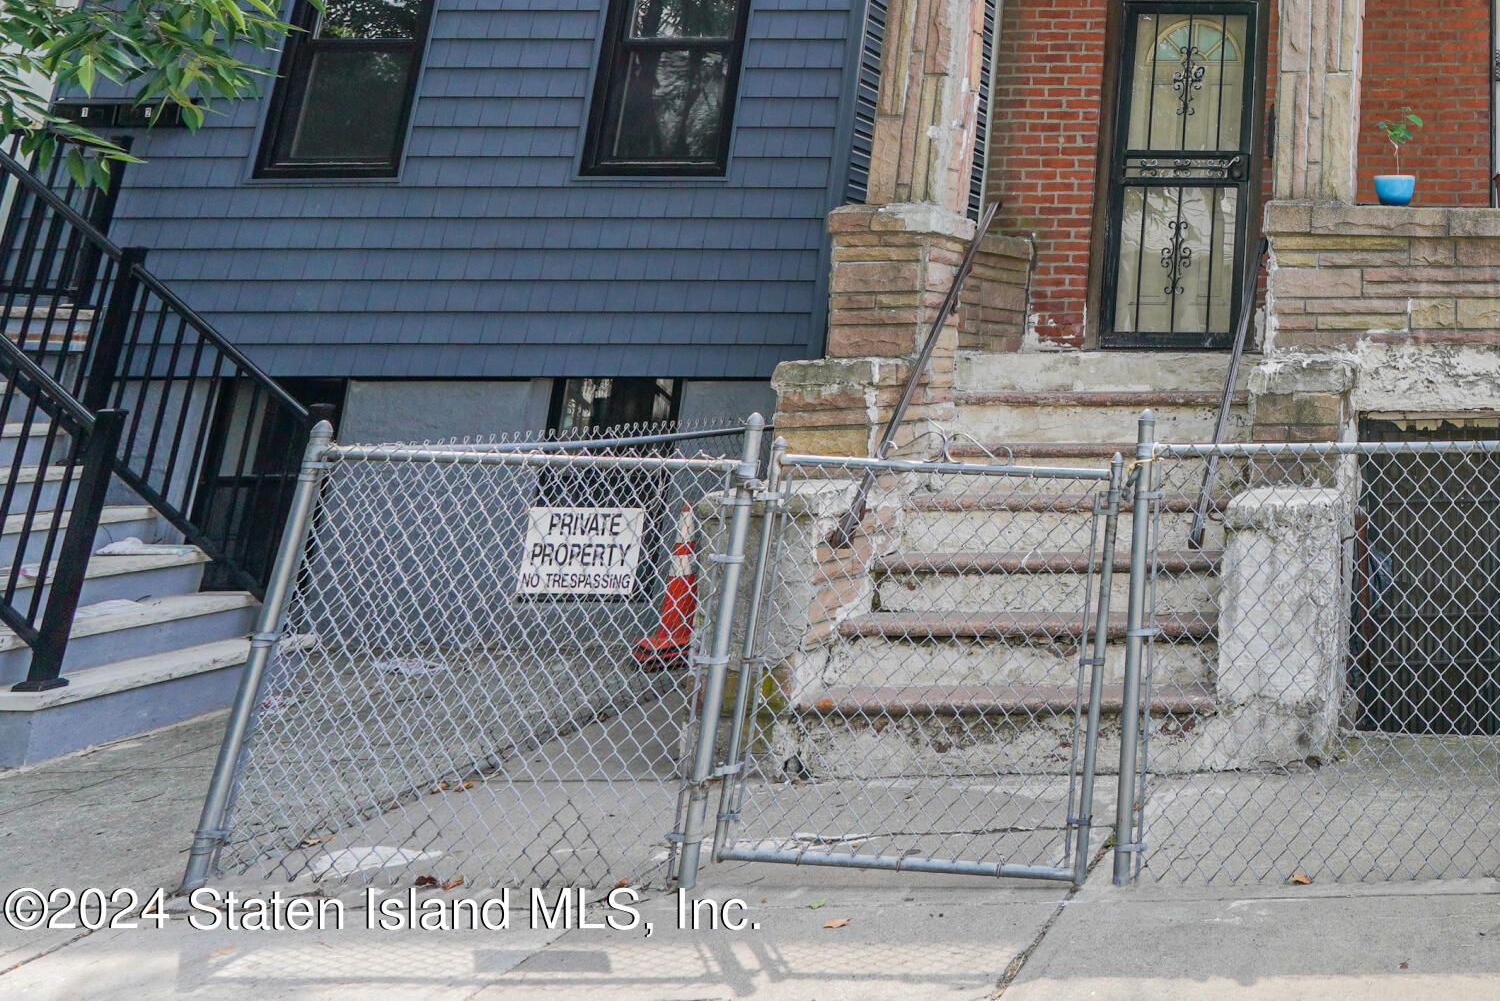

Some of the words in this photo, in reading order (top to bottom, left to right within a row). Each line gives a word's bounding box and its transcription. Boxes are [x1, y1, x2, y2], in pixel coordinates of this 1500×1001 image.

[549, 512, 622, 536] PRIVATE
[531, 542, 632, 567] PROPERTY
[521, 573, 540, 588] NO
[546, 573, 631, 589] TRESPASSING
